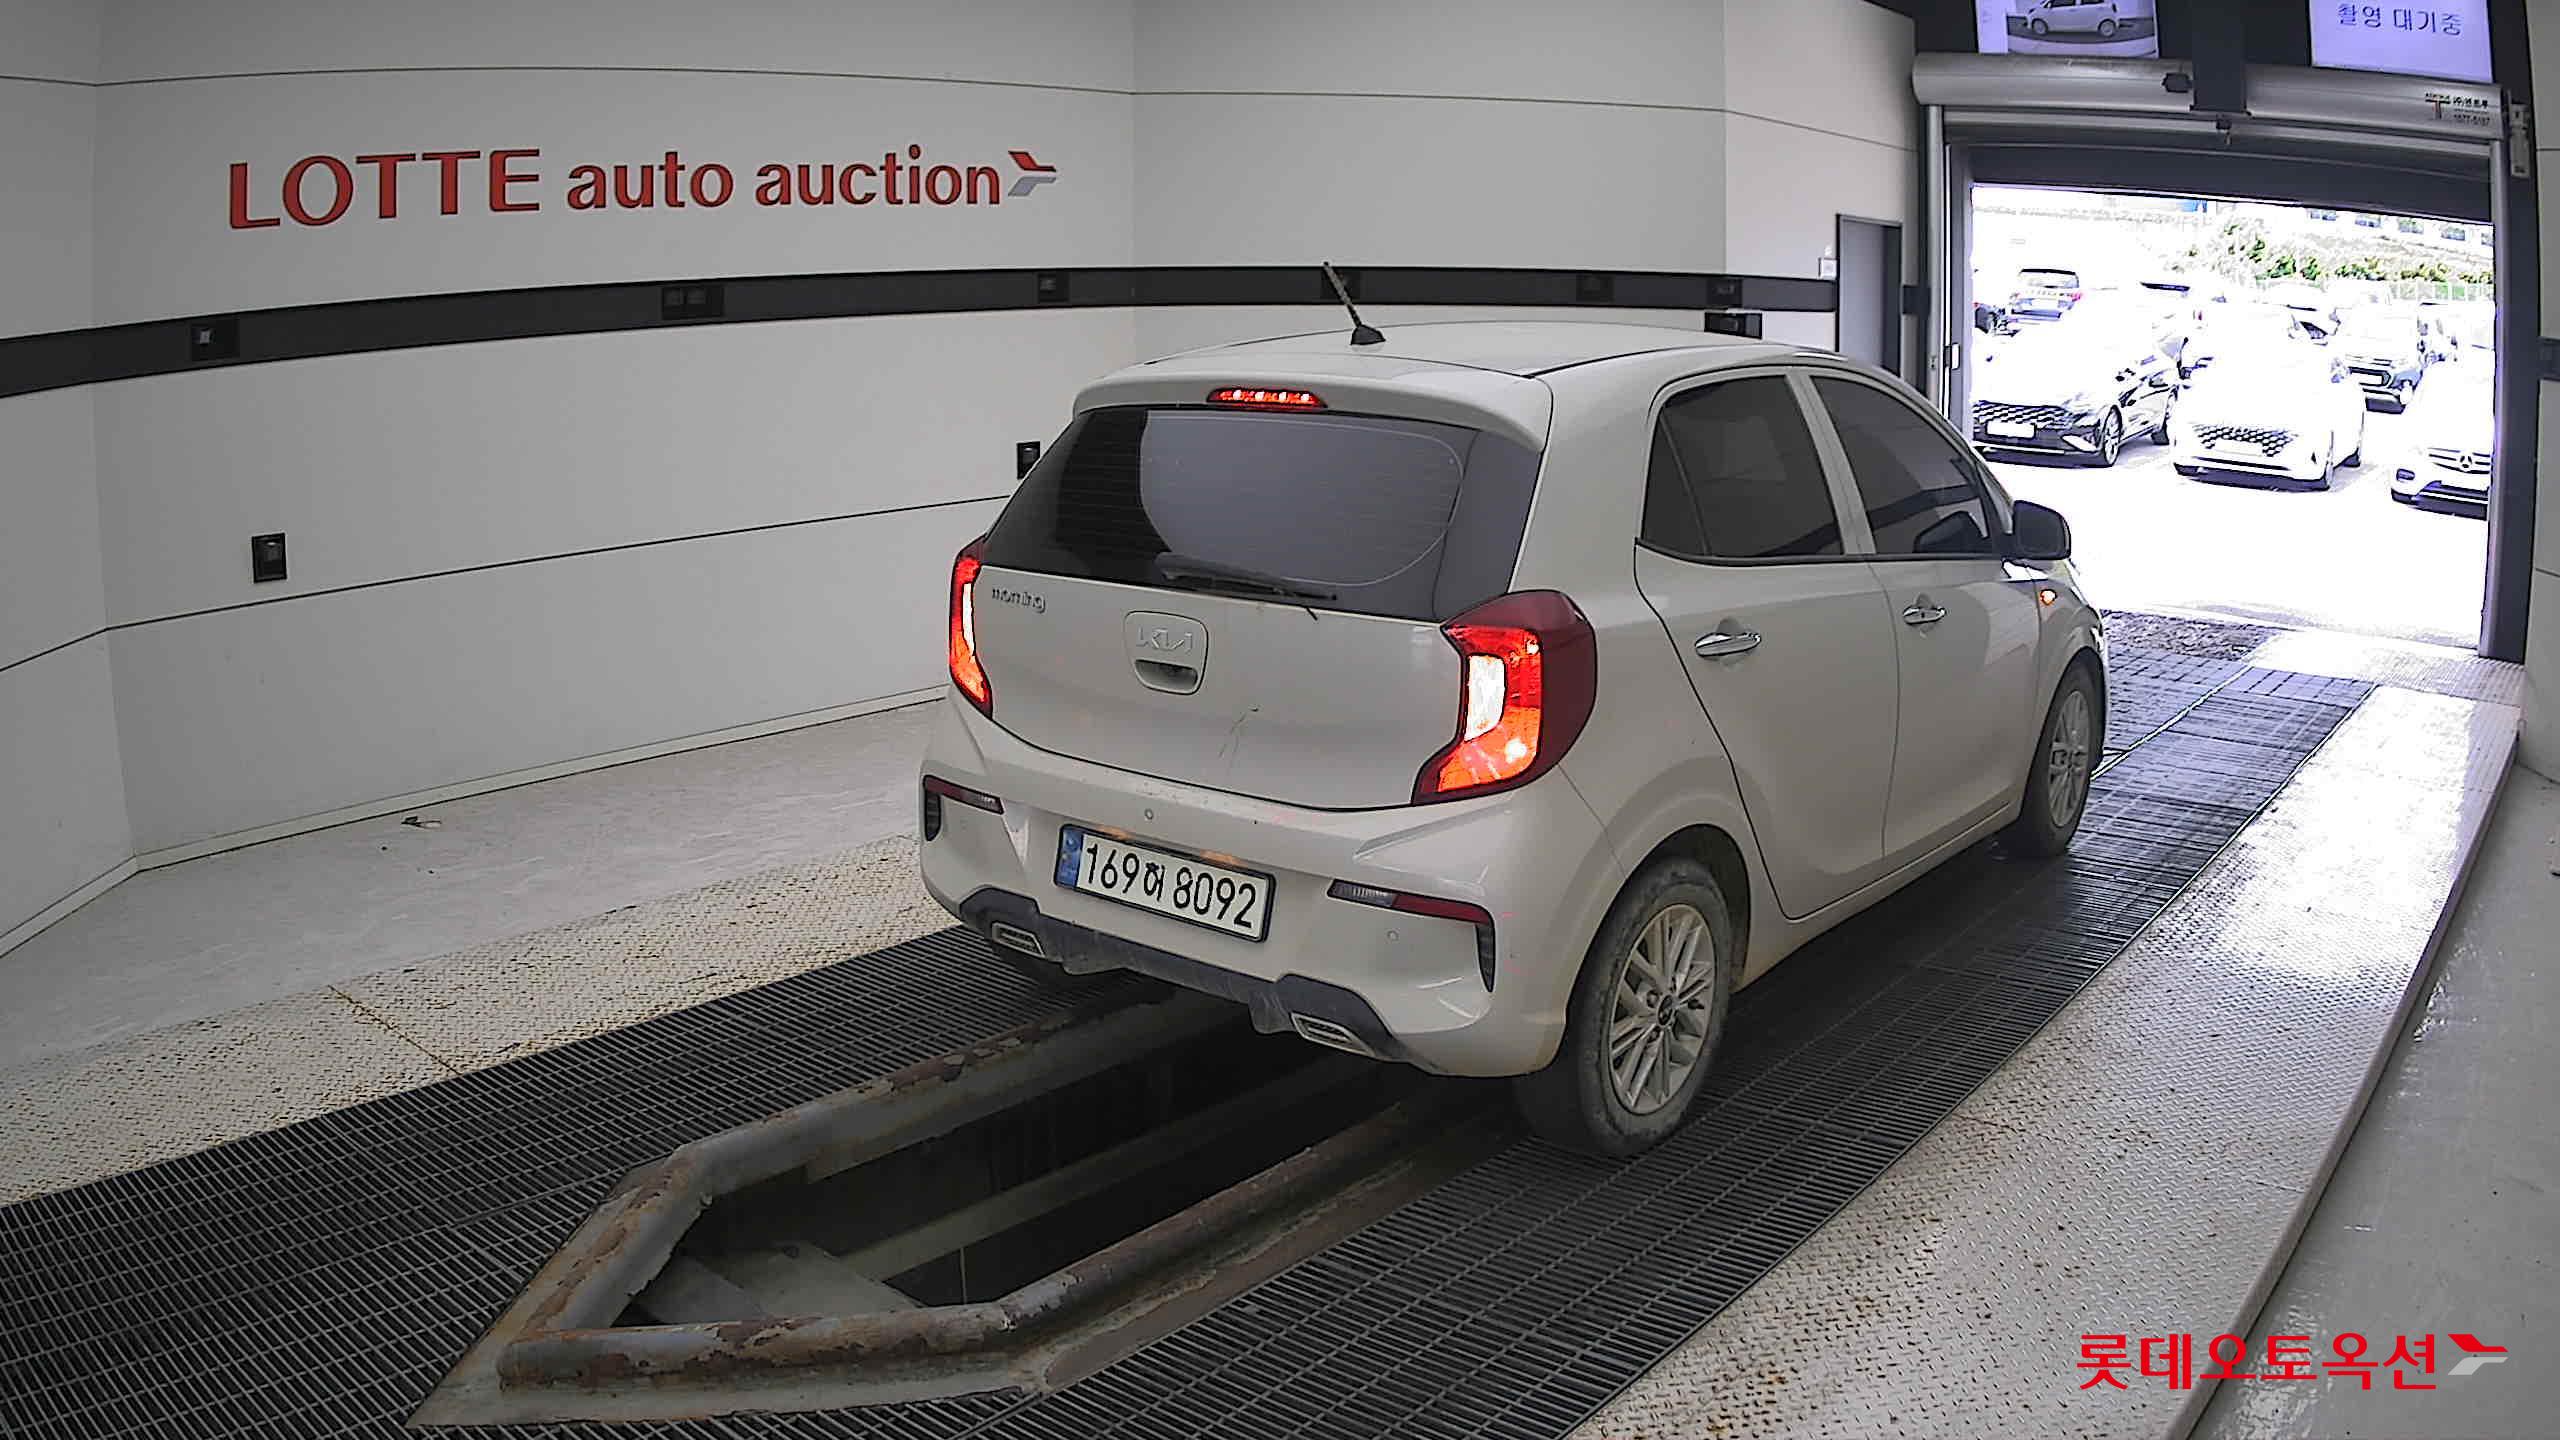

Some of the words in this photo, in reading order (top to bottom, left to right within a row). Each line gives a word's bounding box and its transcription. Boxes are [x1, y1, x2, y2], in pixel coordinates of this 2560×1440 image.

[2338, 4, 2382, 28] 촬영
[2393, 8, 2461, 36] 대기중
[229, 148, 541, 230] LOTTE
[567, 150, 735, 209] auto
[755, 145, 1002, 206] auction
[1086, 843, 1166, 902] 169허
[1174, 866, 1258, 929] 8092
